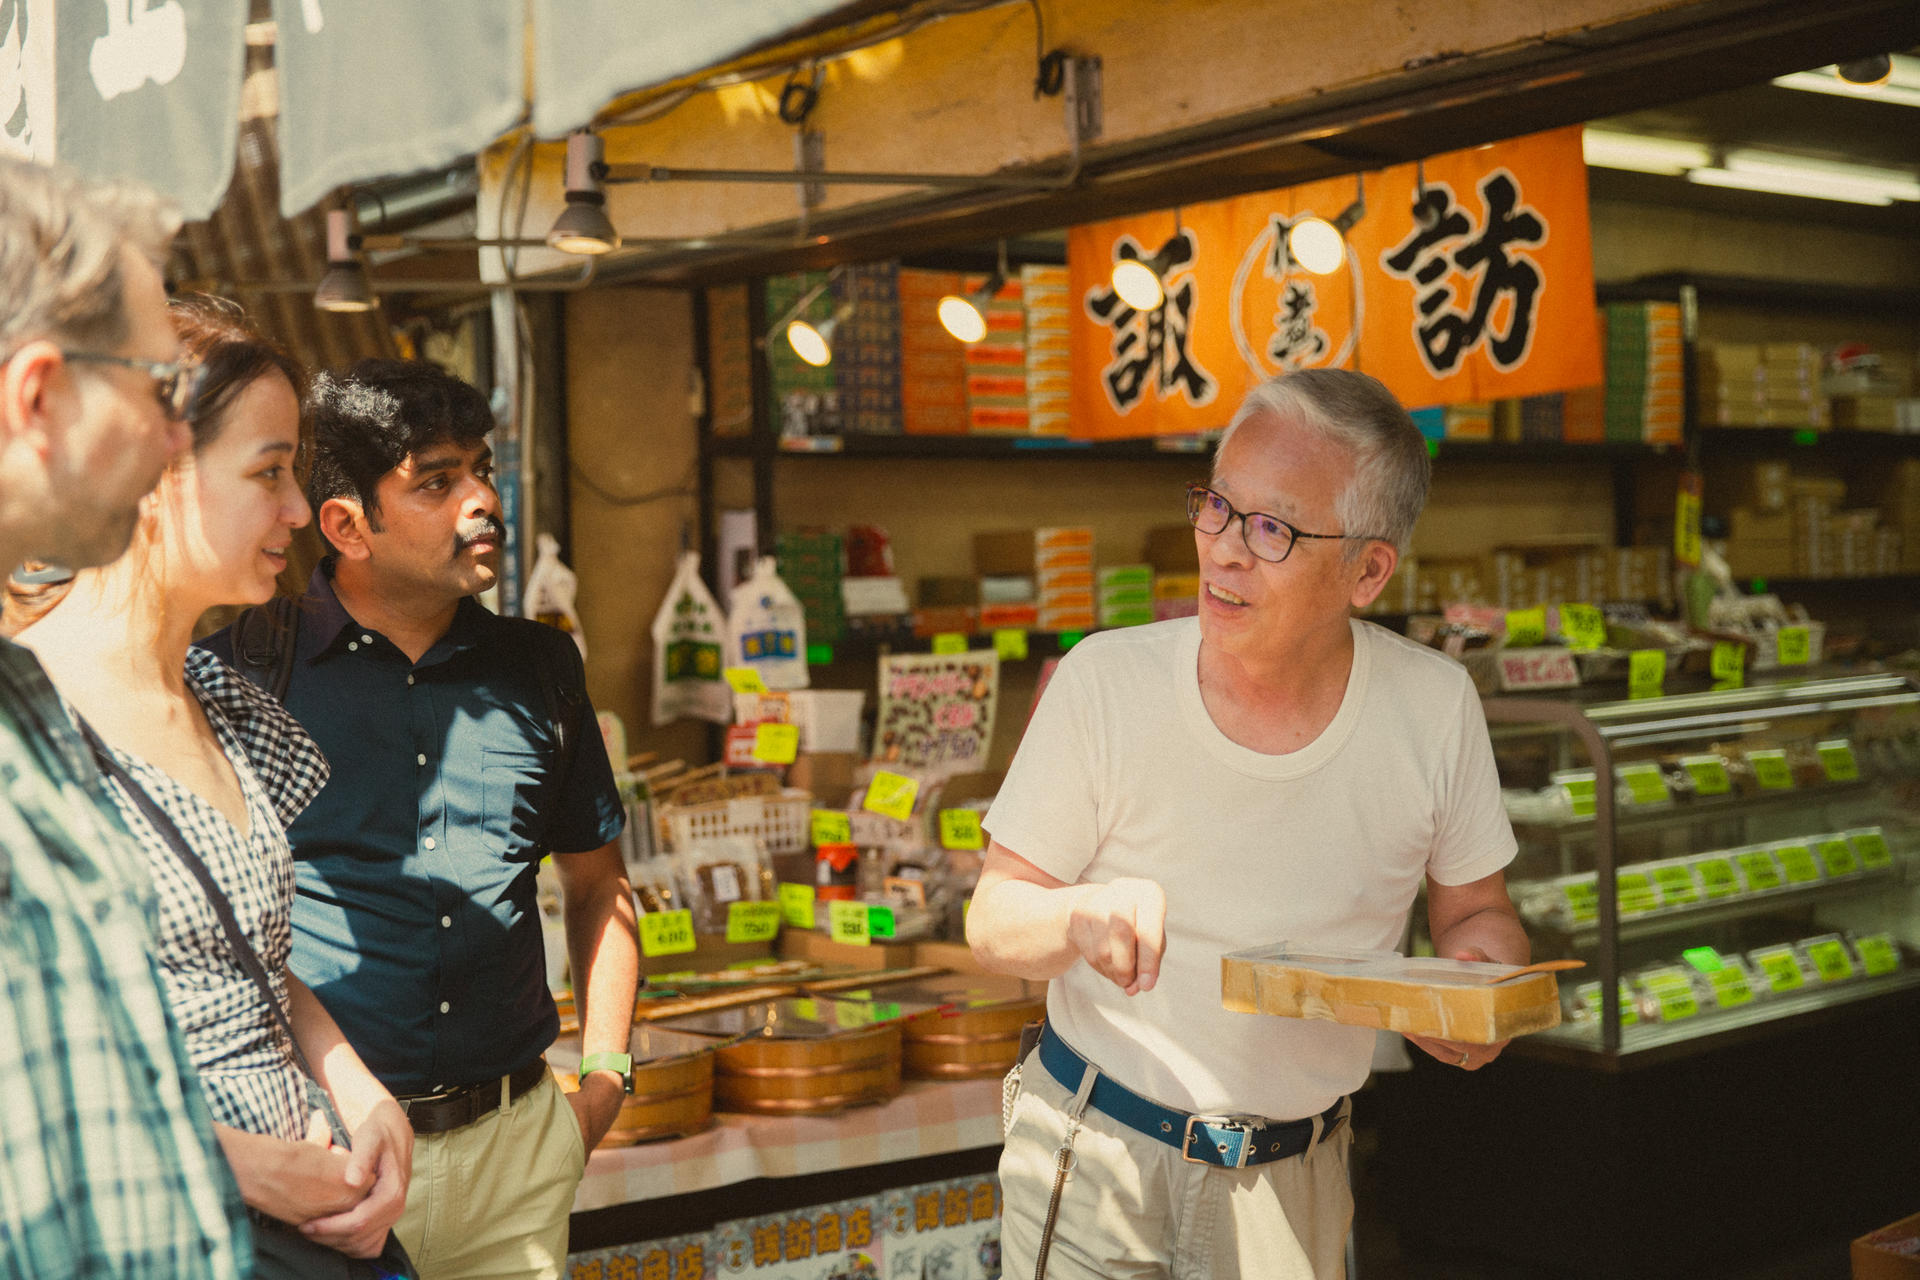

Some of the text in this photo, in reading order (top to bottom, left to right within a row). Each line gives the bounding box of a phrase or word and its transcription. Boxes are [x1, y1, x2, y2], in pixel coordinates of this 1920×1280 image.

[1271, 218, 1328, 367] 煮
[1386, 173, 1544, 371] 訪
[914, 1181, 1003, 1234] 諏訪商
